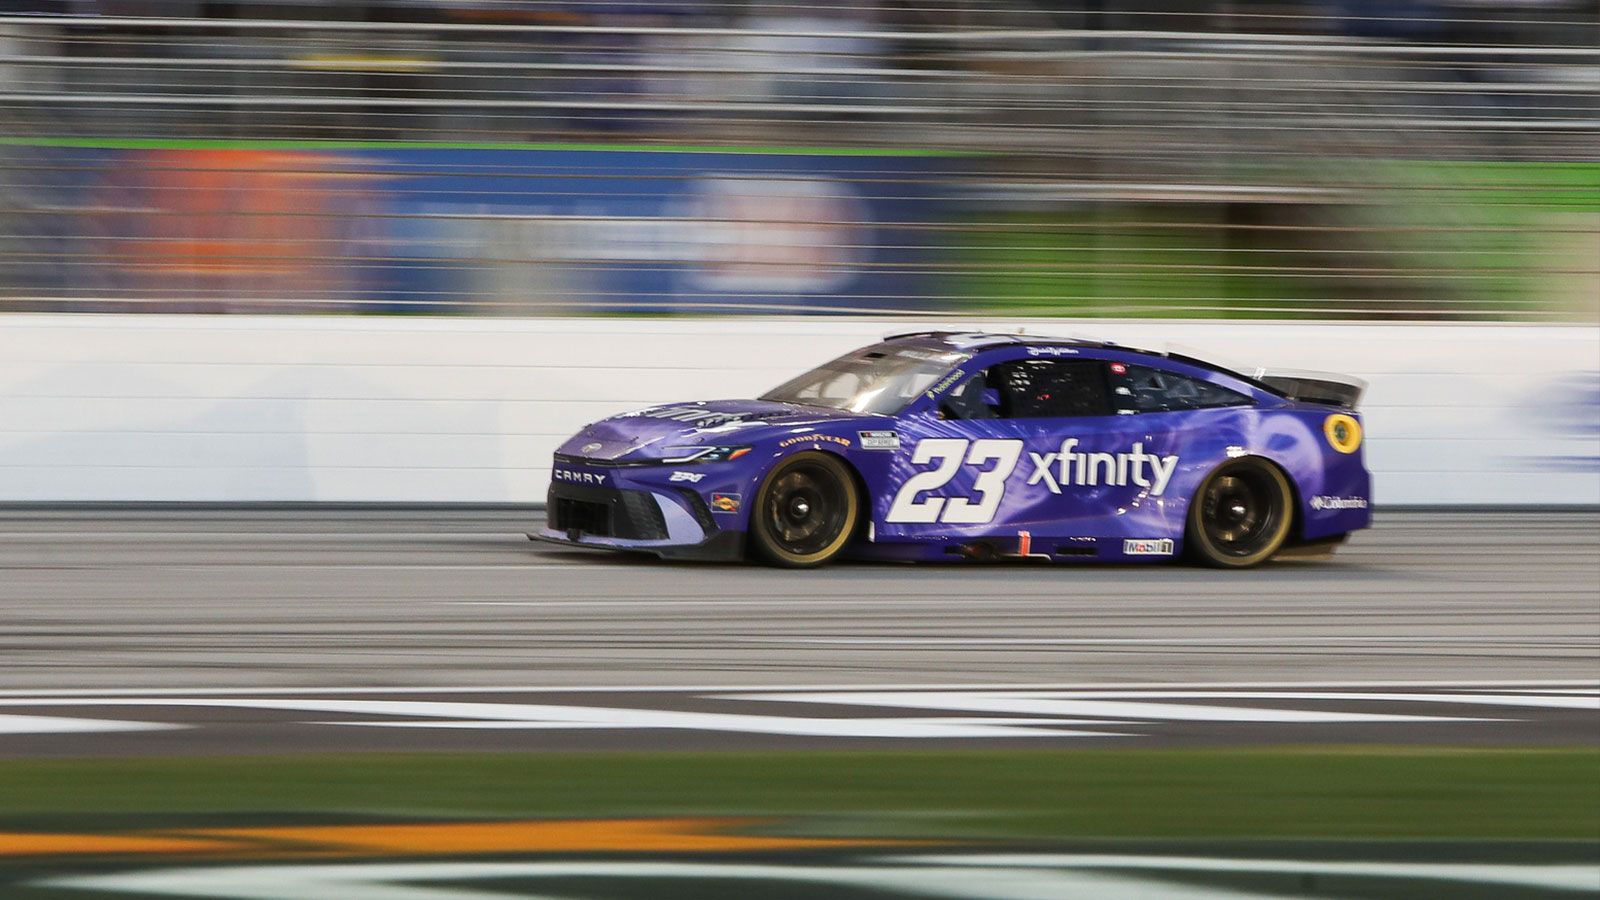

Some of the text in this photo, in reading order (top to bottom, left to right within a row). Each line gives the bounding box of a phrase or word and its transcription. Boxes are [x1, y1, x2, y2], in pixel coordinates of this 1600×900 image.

[779, 433, 851, 447] GOODYEAR
[1026, 438, 1180, 496] xfinity
[555, 469, 606, 485] CAMRY
[886, 438, 1024, 523] 23
[1128, 541, 1159, 553] Mobil
